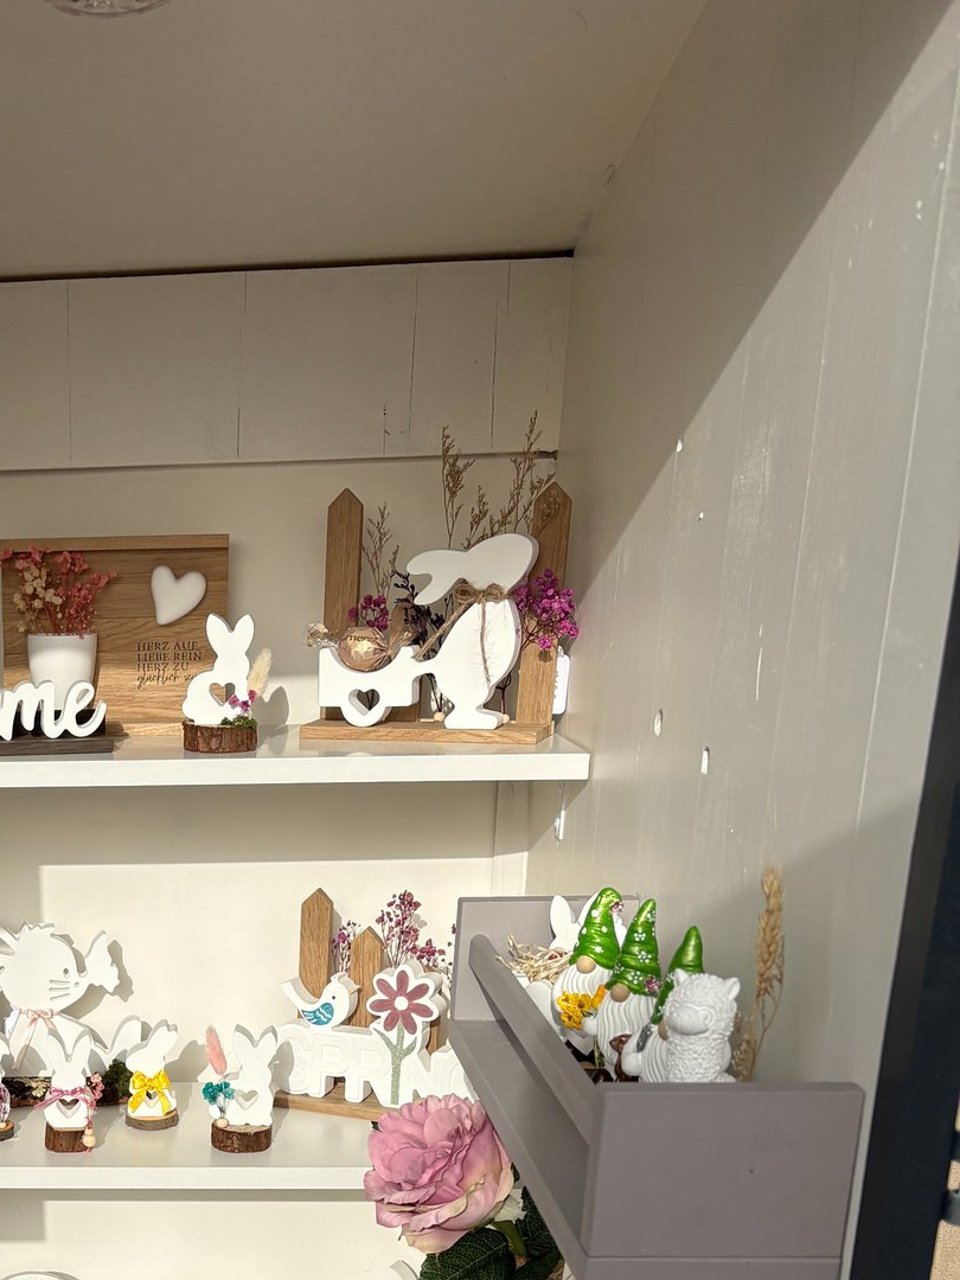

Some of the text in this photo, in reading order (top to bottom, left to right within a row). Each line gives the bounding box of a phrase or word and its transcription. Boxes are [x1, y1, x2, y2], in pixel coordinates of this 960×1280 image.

[137, 641, 169, 652] HERZ
[137, 651, 202, 662] LIEBE REIN
[137, 662, 190, 672] HERZ ZU
